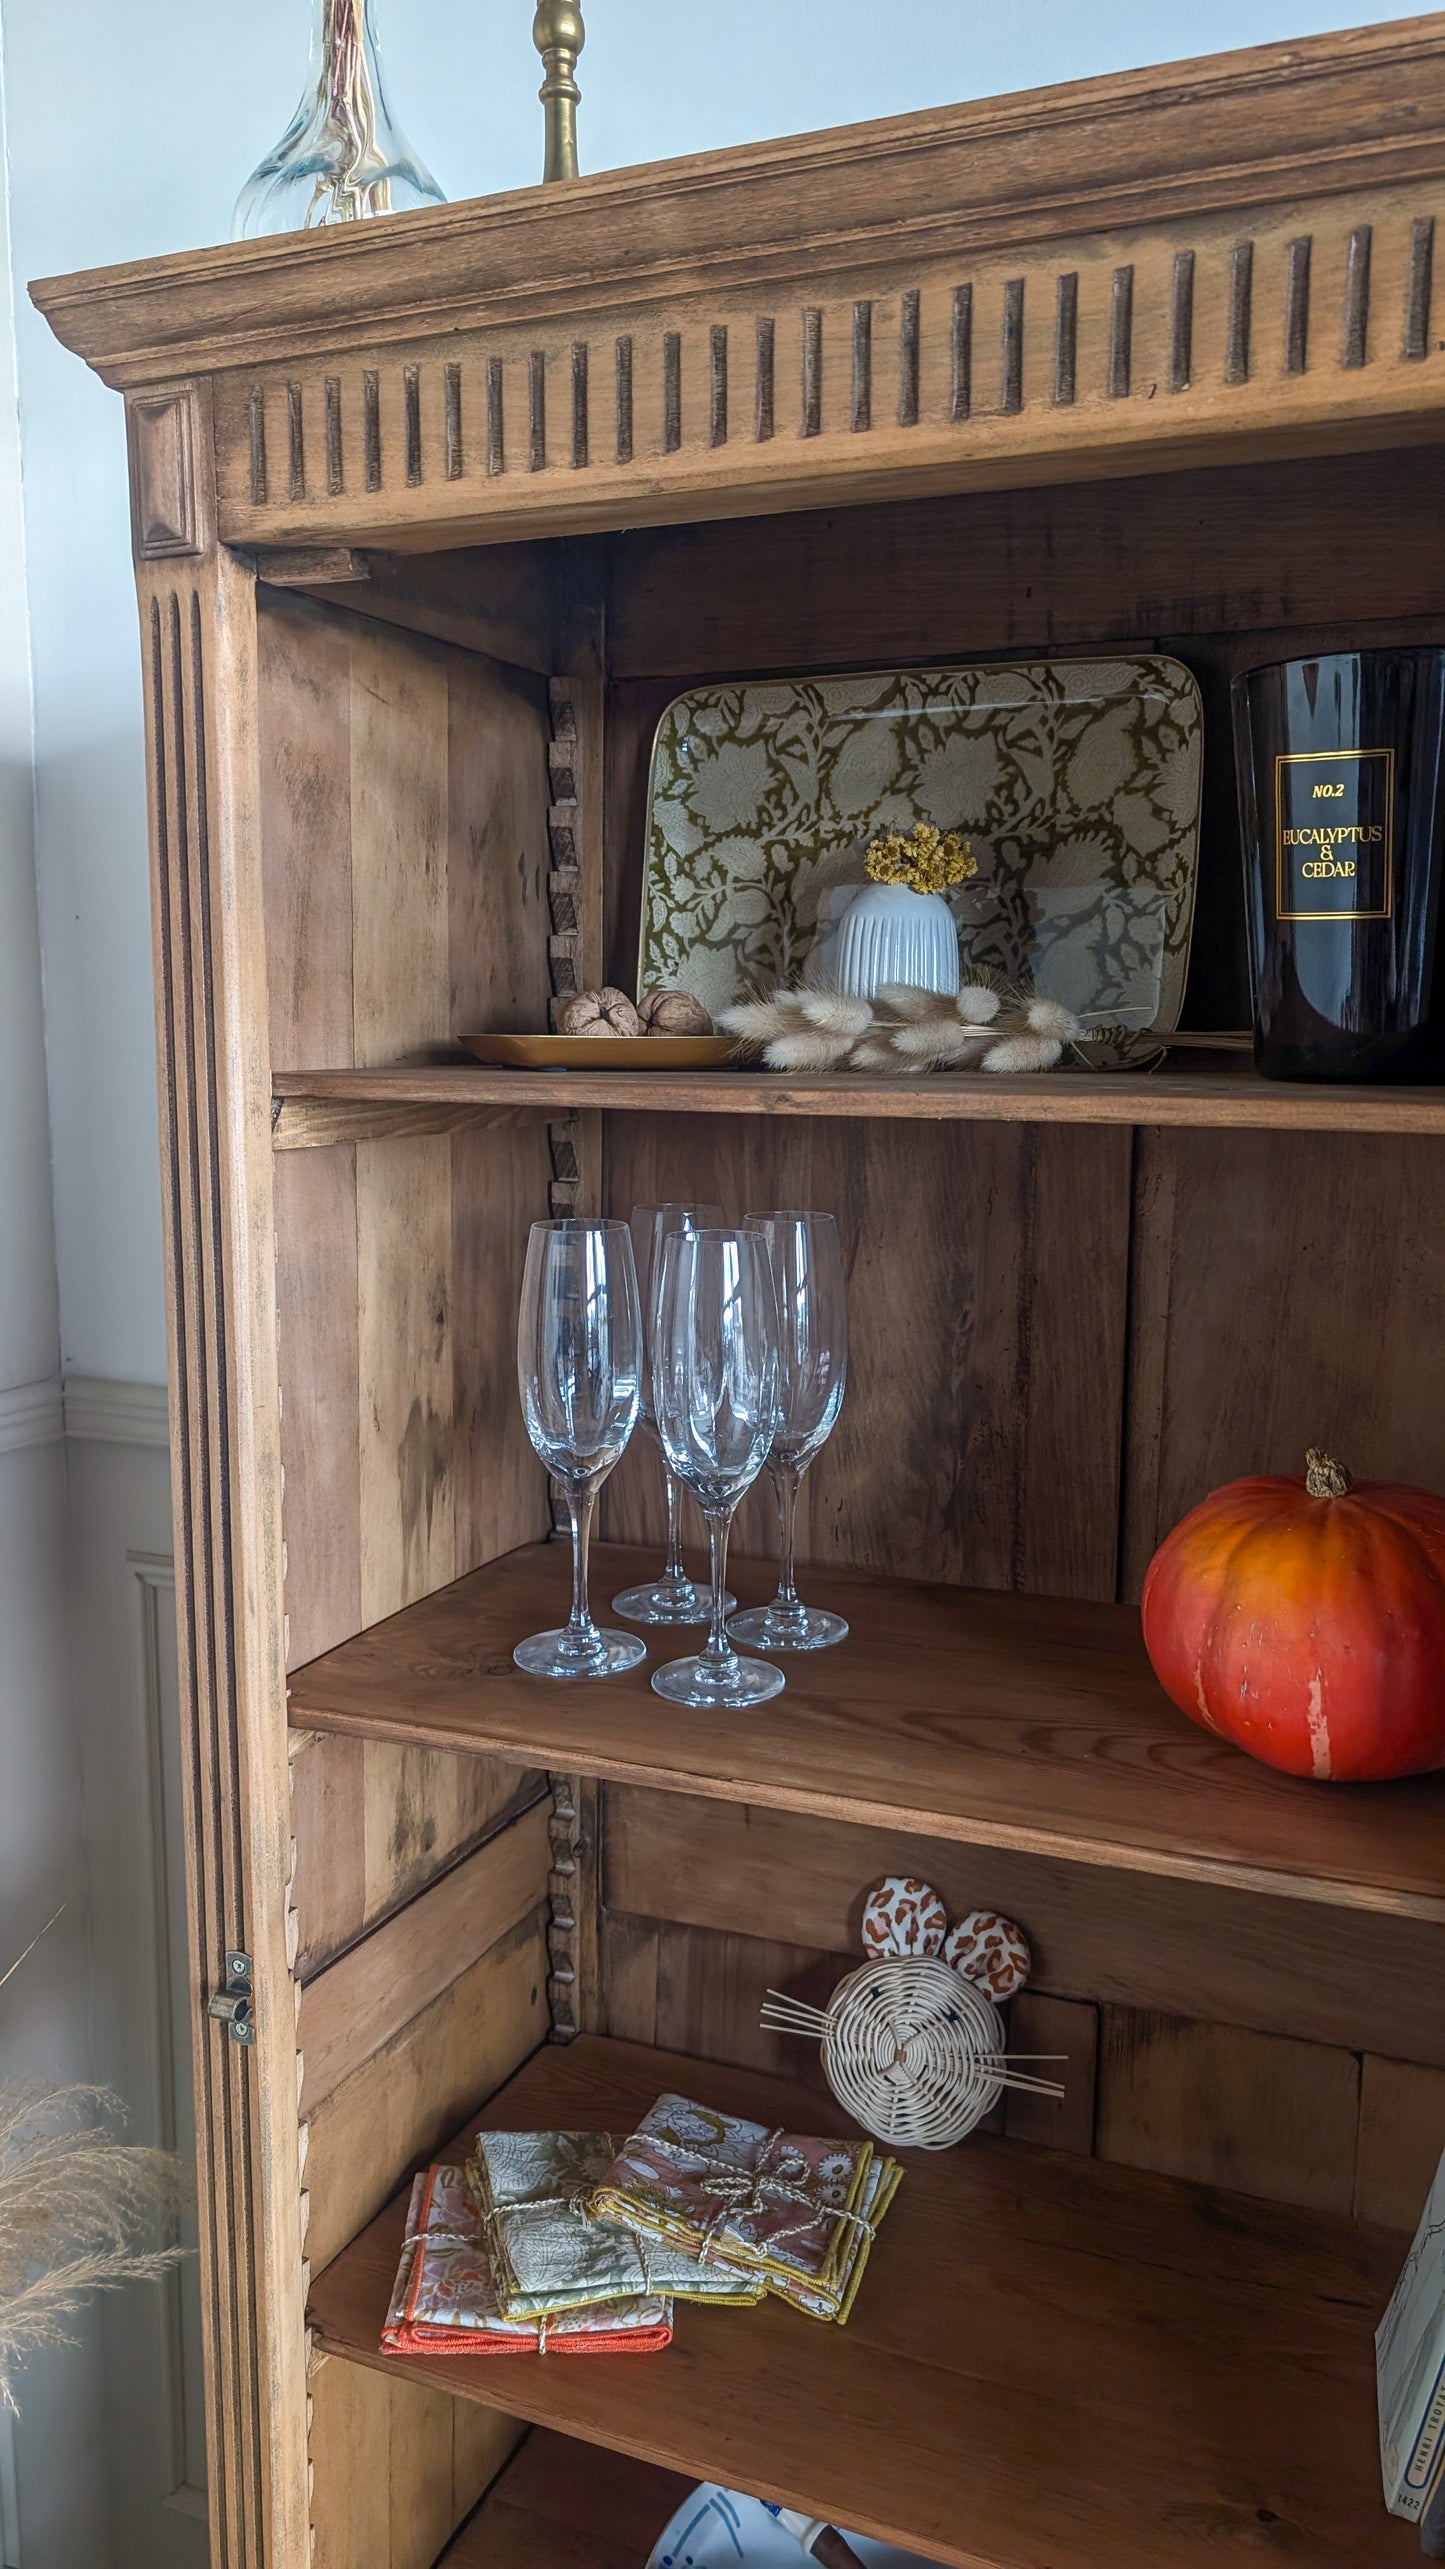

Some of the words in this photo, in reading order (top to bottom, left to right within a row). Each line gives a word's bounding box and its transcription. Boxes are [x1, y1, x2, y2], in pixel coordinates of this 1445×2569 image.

[1313, 785, 1344, 798] NO.2
[1284, 827, 1382, 845] EUCALYPTUS
[1321, 845, 1333, 860] &
[1302, 862, 1355, 878] CEDAR
[1414, 2437, 1432, 2472] HENRI
[1398, 2494, 1420, 2511] 1422
